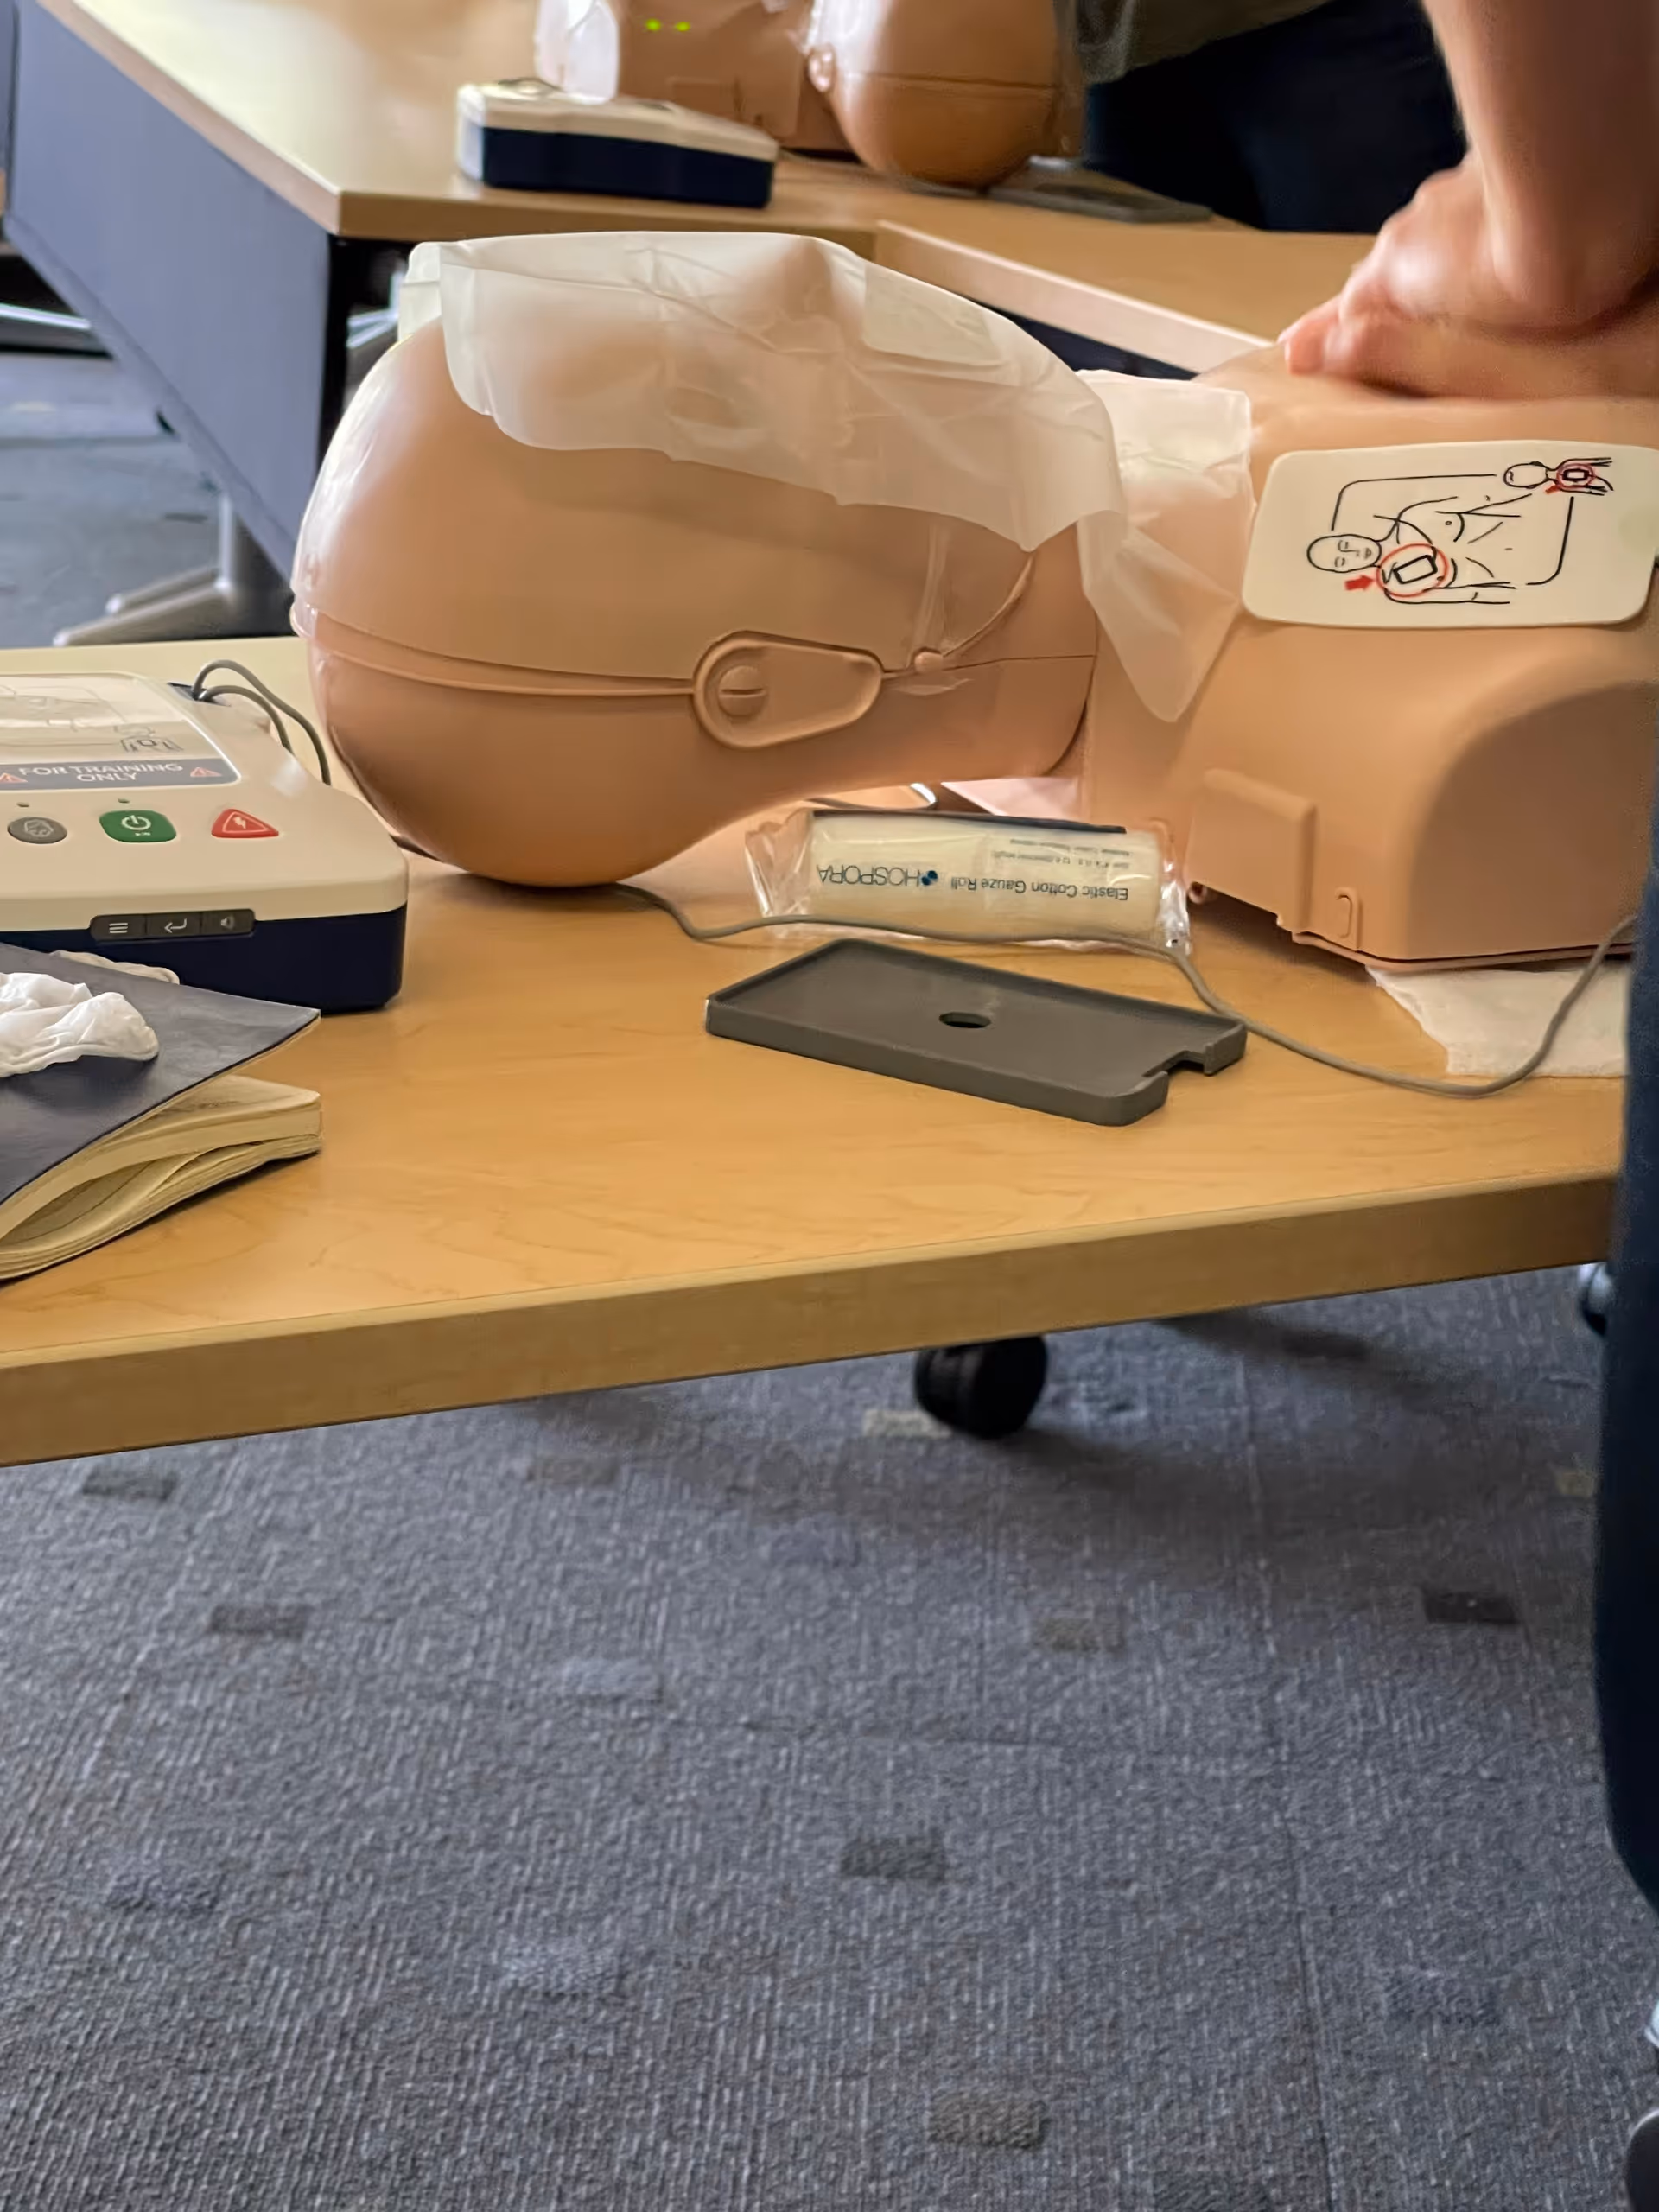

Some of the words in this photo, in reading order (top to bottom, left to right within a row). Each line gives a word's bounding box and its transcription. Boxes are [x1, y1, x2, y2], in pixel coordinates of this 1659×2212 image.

[18, 765, 68, 776] FOR
[69, 762, 183, 774] TRAINING
[77, 772, 137, 782] ONLY
[817, 864, 920, 887] HOSPORA
[951, 876, 977, 891] Roll
[982, 878, 1027, 893] Gauze
[1032, 881, 1077, 898] Cotton
[1082, 886, 1128, 900] Elastic
